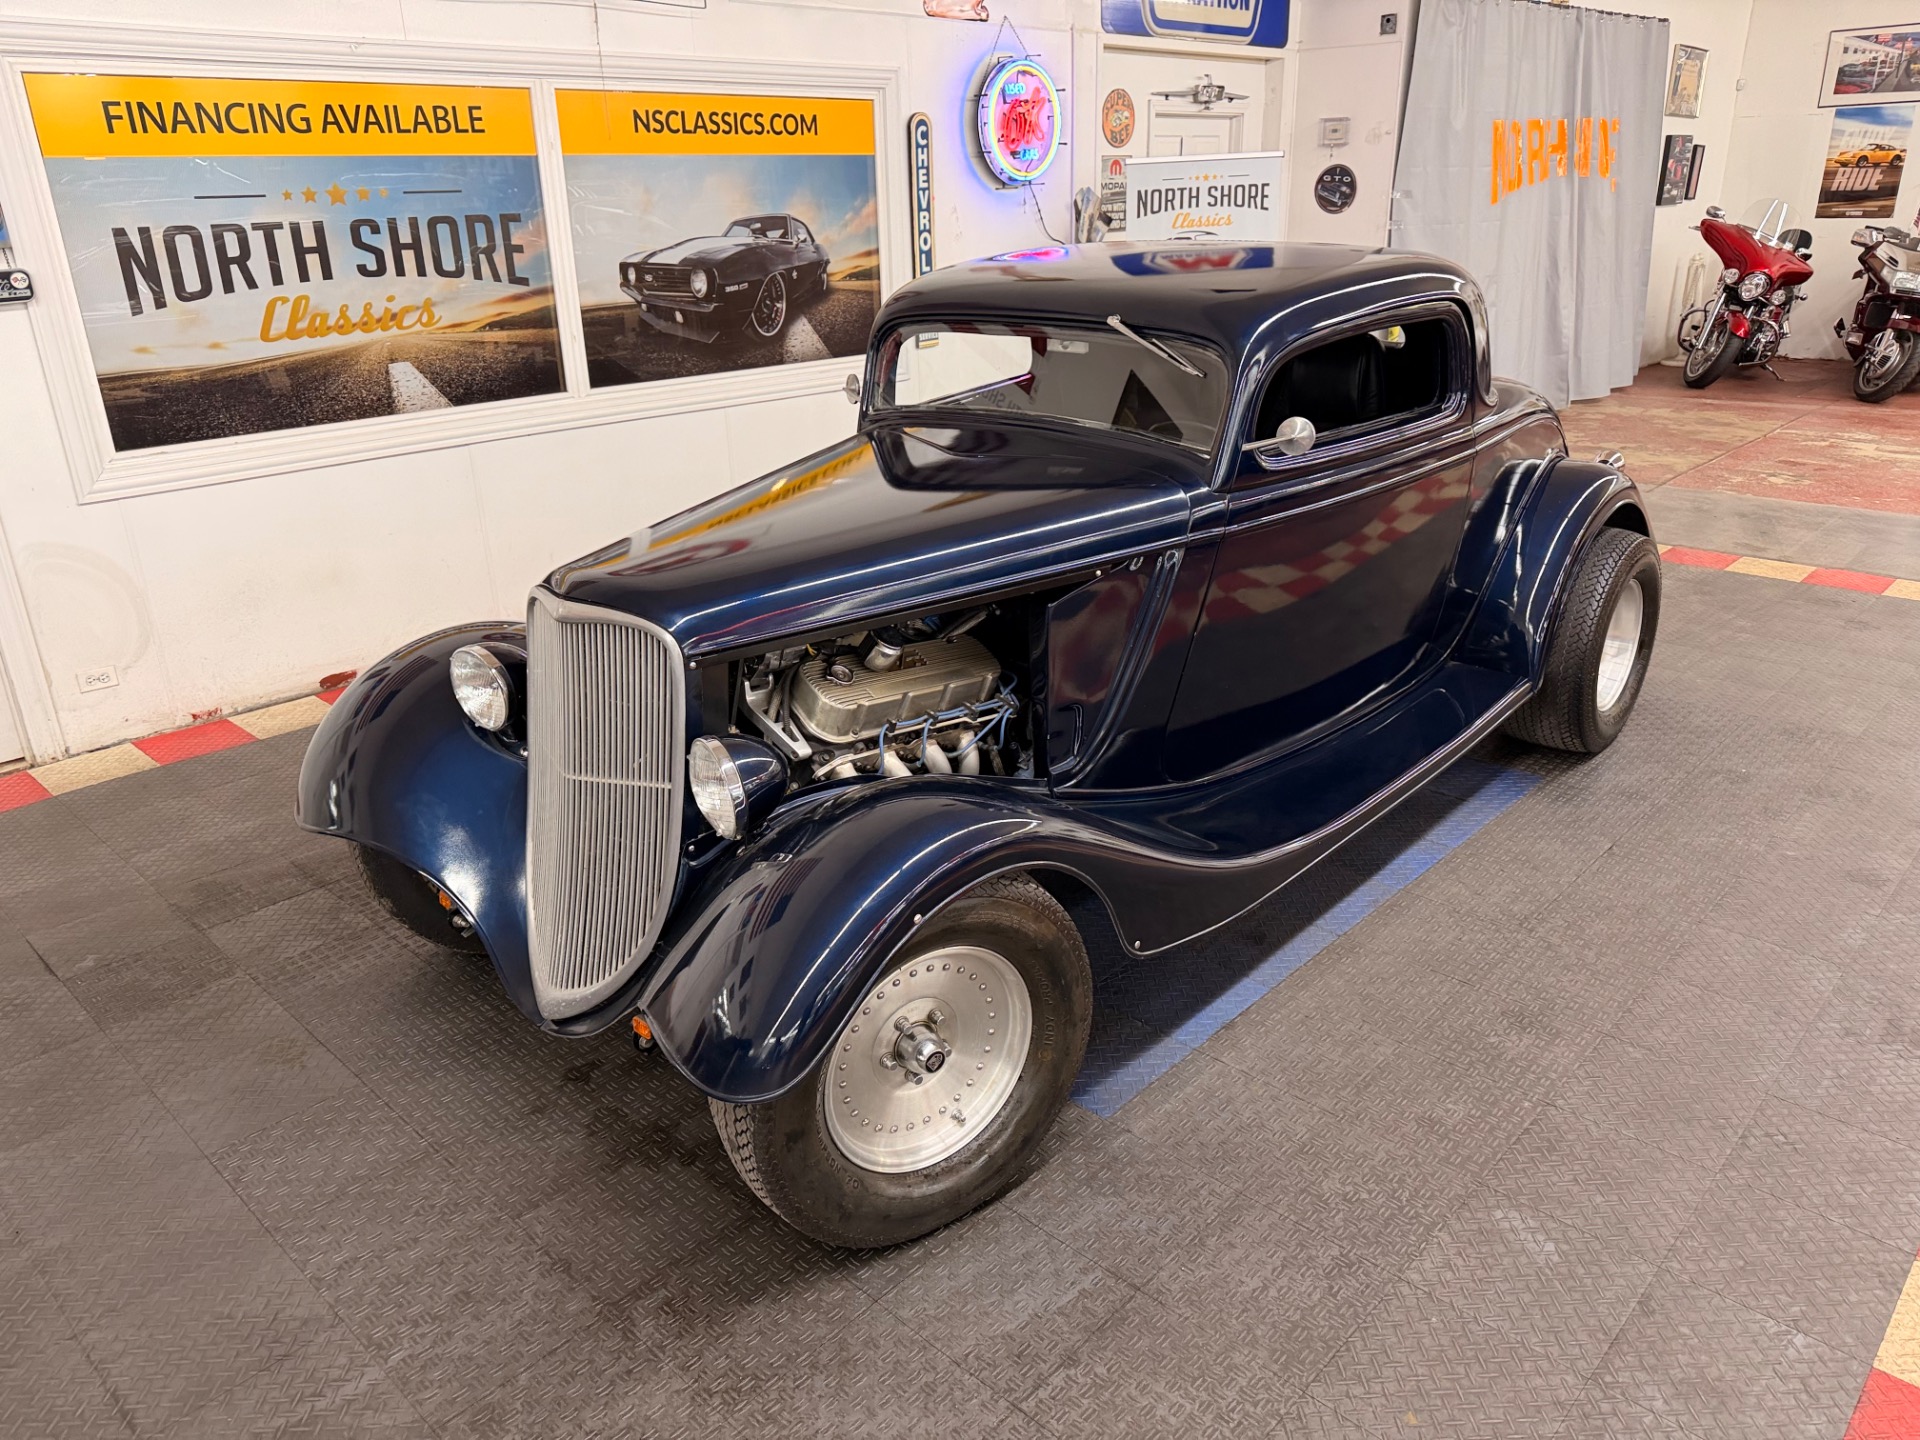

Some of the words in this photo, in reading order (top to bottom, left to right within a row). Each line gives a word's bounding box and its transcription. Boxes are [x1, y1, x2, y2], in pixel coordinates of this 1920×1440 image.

[1004, 83, 1026, 95] USED
[101, 101, 312, 135] FINANCING
[321, 104, 486, 135] AVAILABLE
[632, 109, 819, 137] NSCLASSICS.COM
[1109, 123, 1131, 144] BEE
[1101, 181, 1127, 191] MOPA
[1323, 174, 1351, 183] GTO
[1830, 166, 1887, 191] RIDE
[916, 125, 932, 273] CHEVROL
[1136, 186, 1200, 219] NORTH
[1207, 182, 1270, 211] SHORE
[1171, 212, 1233, 230] Classics
[111, 220, 333, 317] NORTH
[350, 212, 531, 287] SHORE
[259, 294, 443, 343] Classics
[1043, 1015, 1055, 1045] INDY
